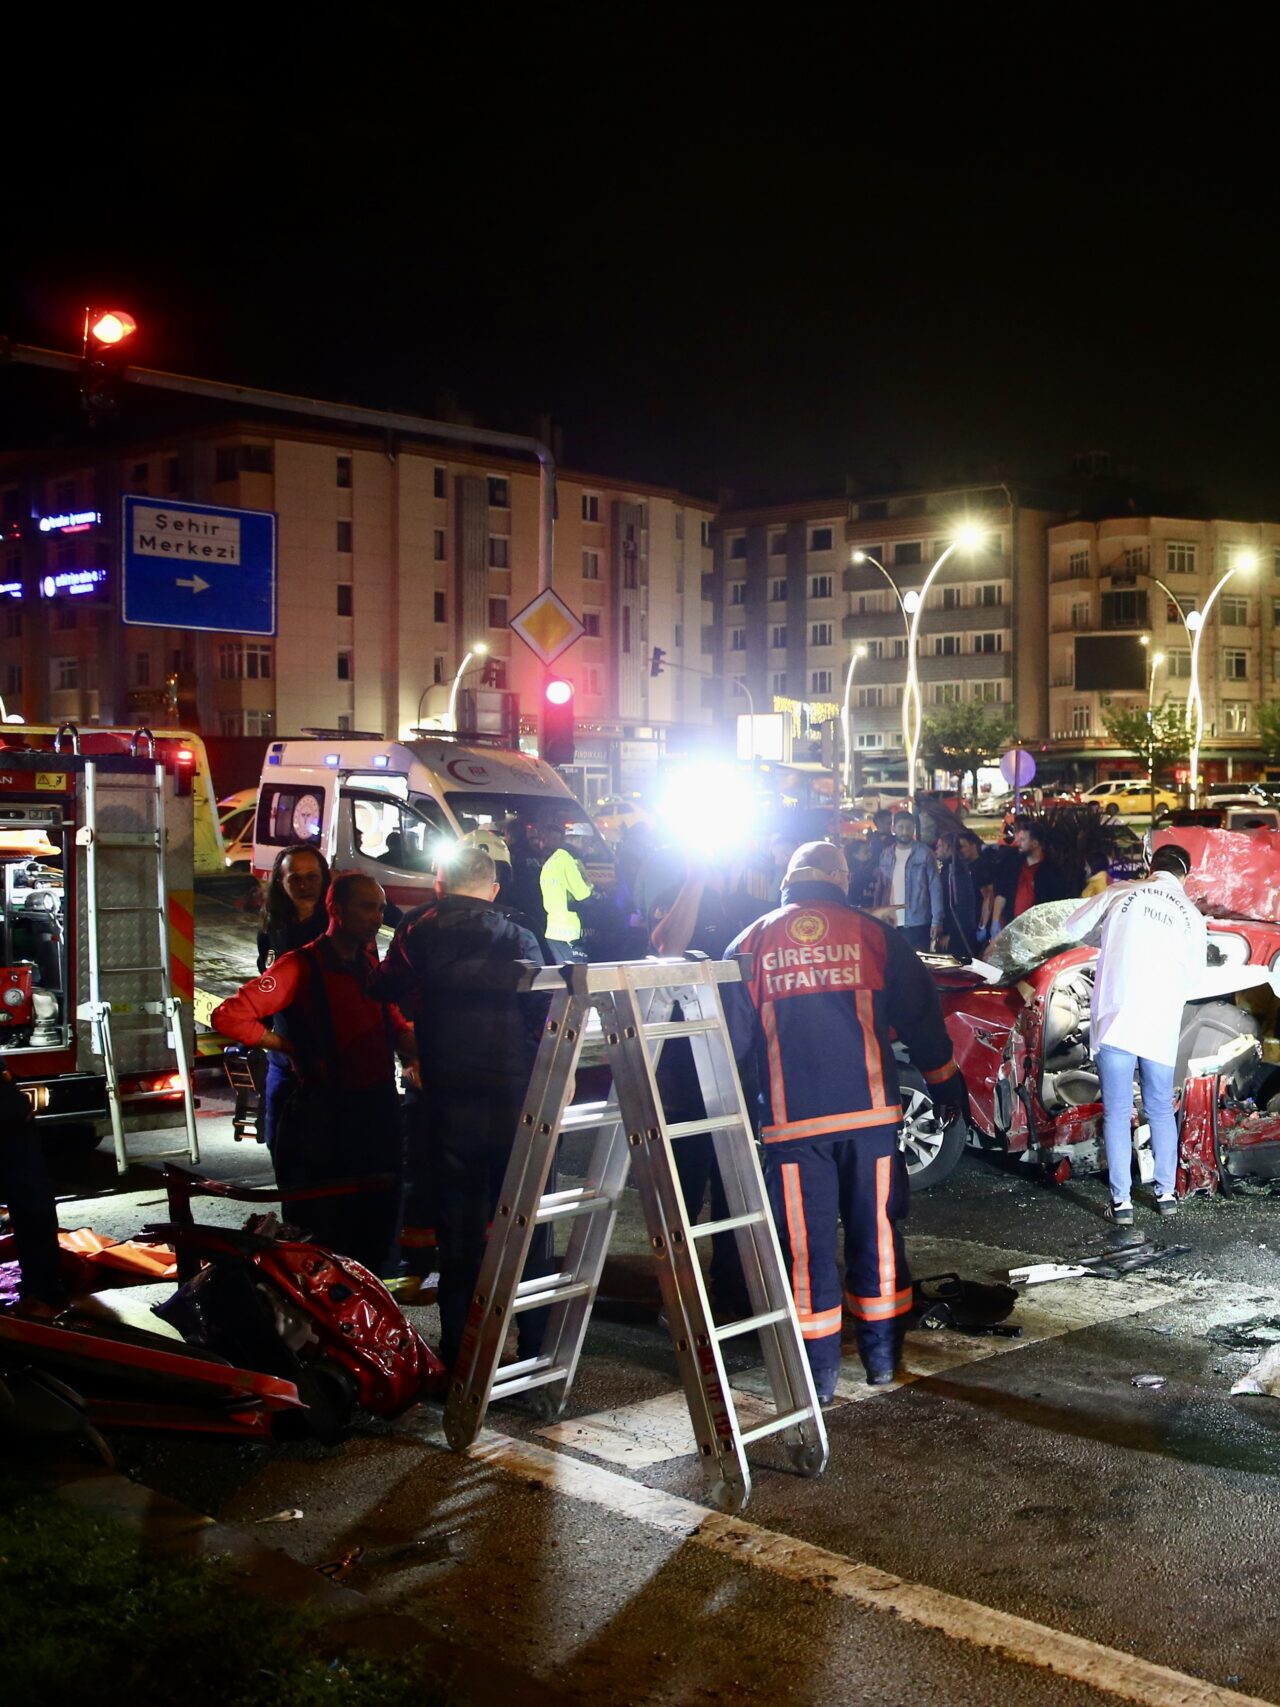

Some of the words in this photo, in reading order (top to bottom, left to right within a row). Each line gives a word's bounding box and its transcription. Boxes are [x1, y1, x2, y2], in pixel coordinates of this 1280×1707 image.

[139, 534, 235, 559] Merkezi
[1121, 891, 1138, 913] OLAY
[762, 943, 861, 971] GİRESUN
[766, 963, 861, 994] İTFAİYESİ
